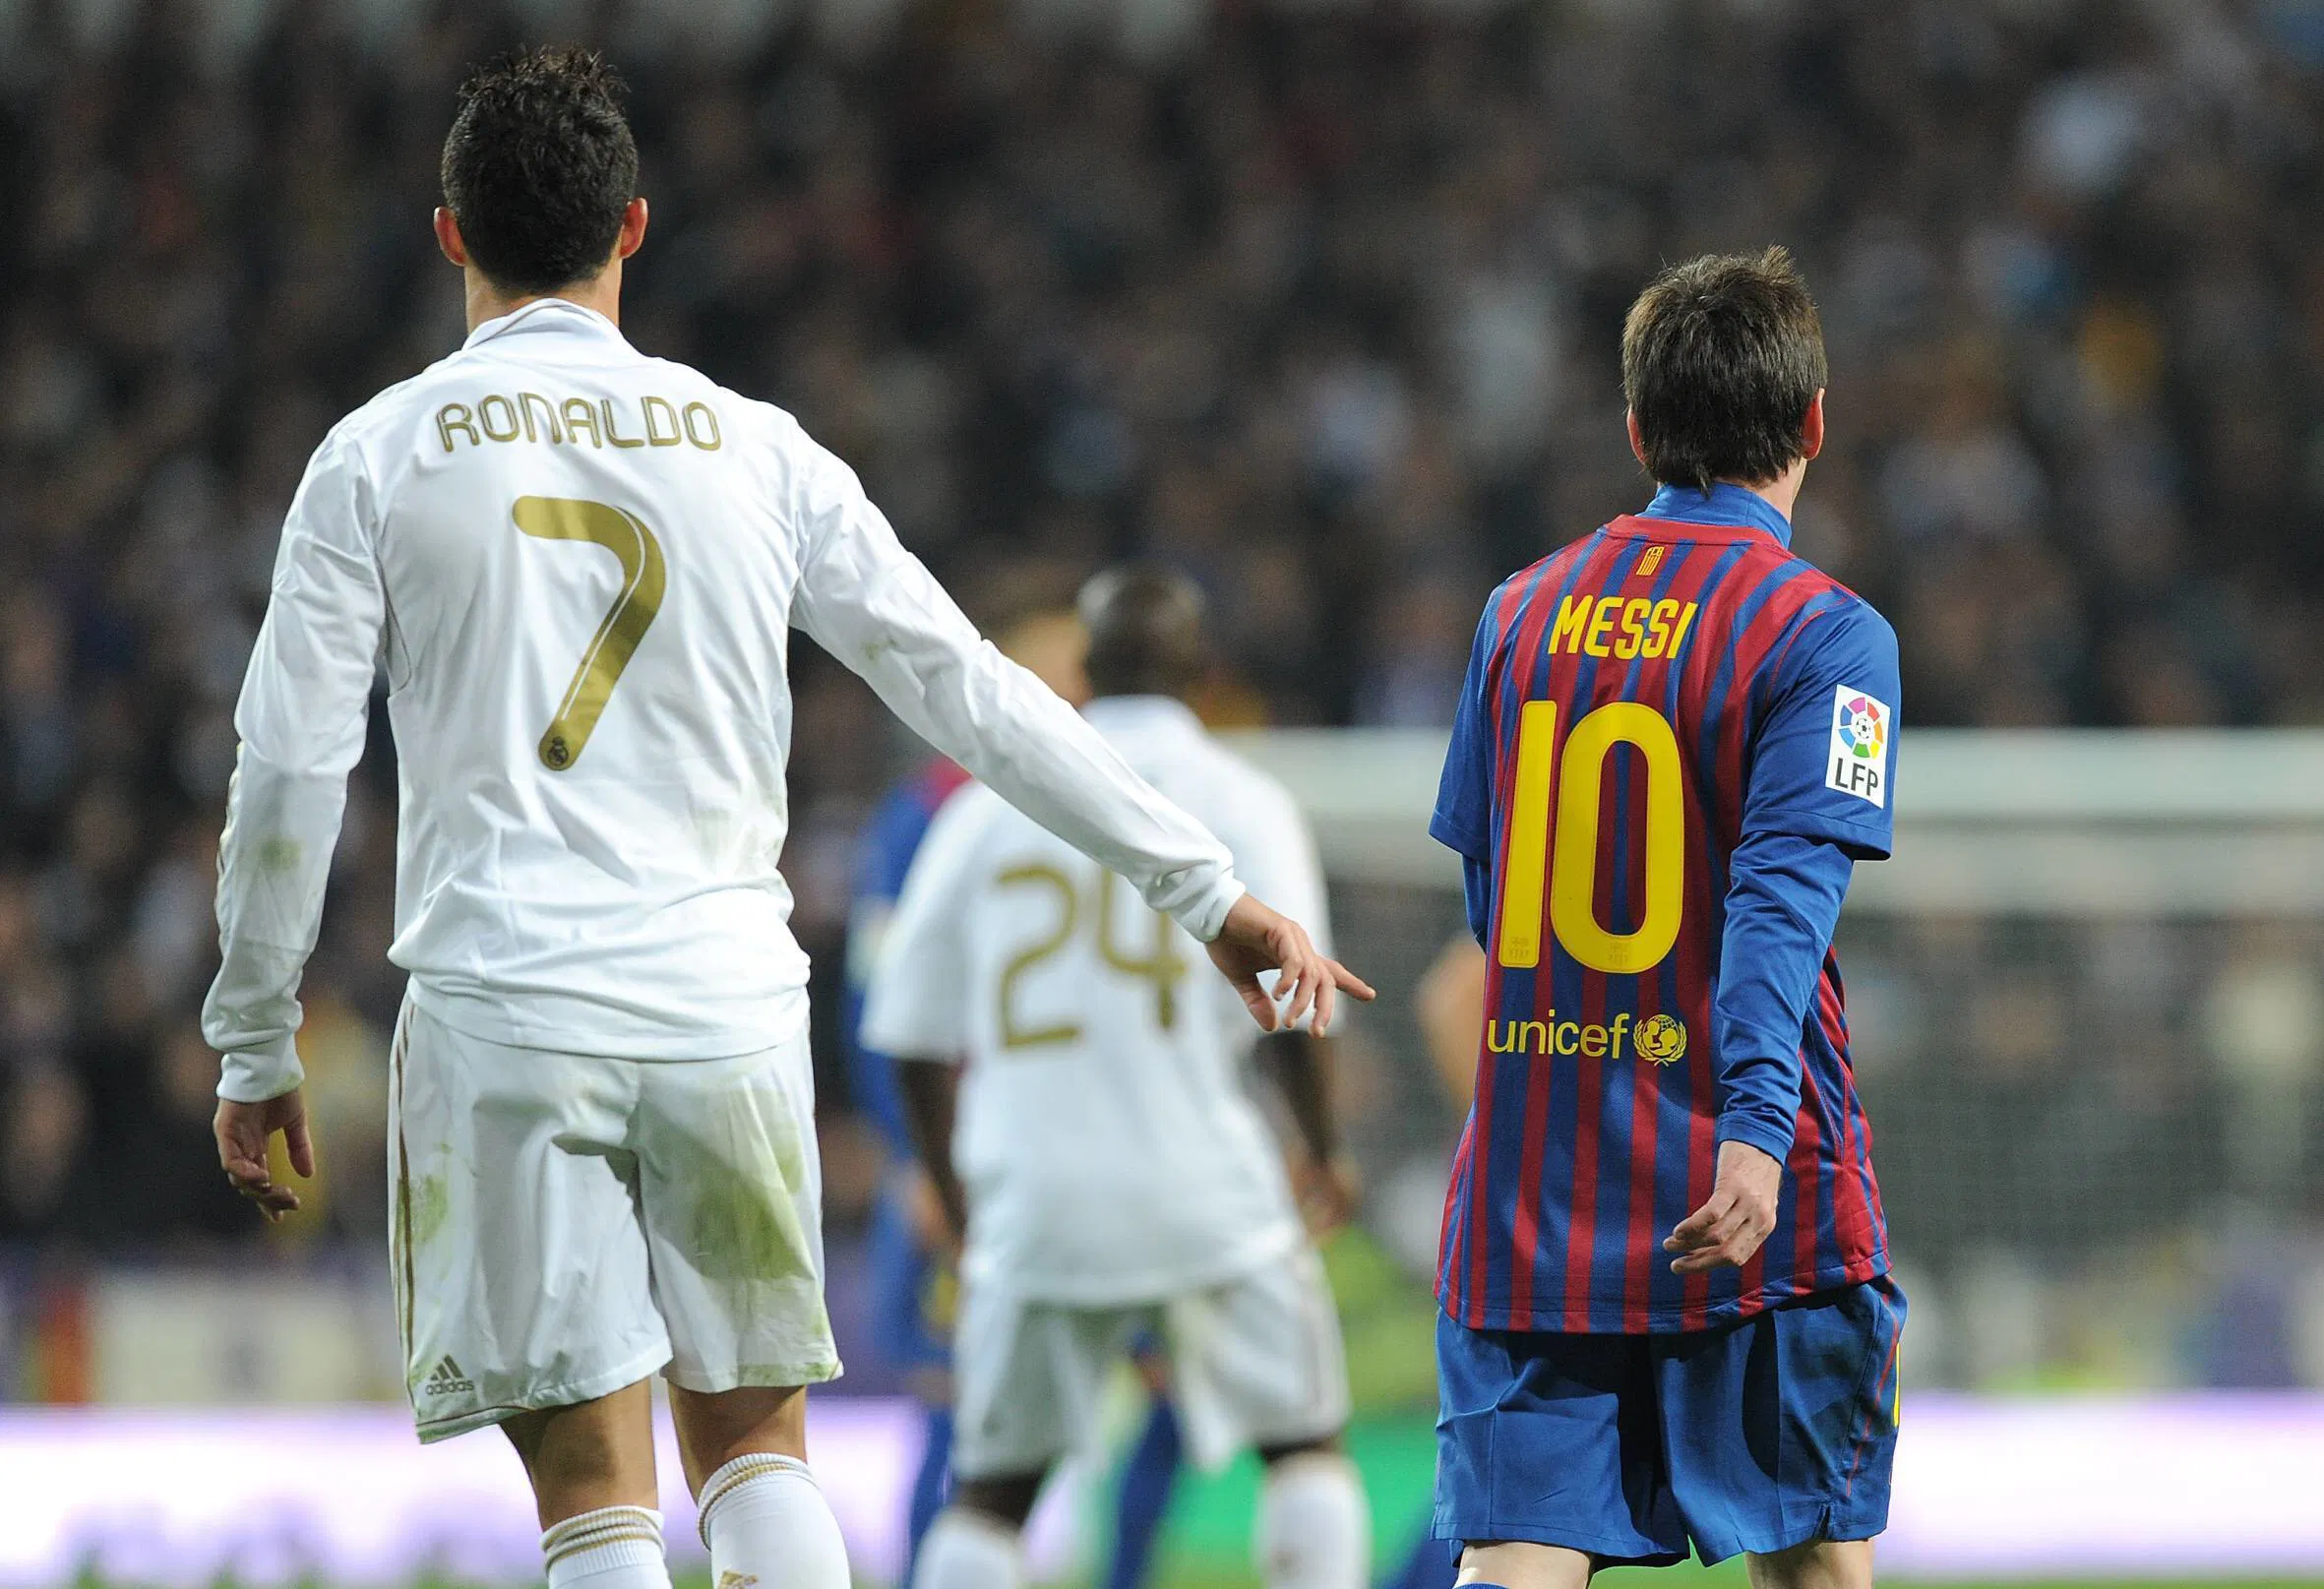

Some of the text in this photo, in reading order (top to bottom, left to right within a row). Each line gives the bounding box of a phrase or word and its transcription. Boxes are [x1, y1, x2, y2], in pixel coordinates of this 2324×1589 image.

[437, 393, 721, 453] RONALDO
[513, 495, 666, 771] 7
[1548, 594, 1698, 659] MESSI
[1835, 758, 1878, 797] LFP
[1498, 700, 1683, 973] 10
[997, 862, 1189, 1048] 24
[1487, 1008, 1630, 1060] unicef
